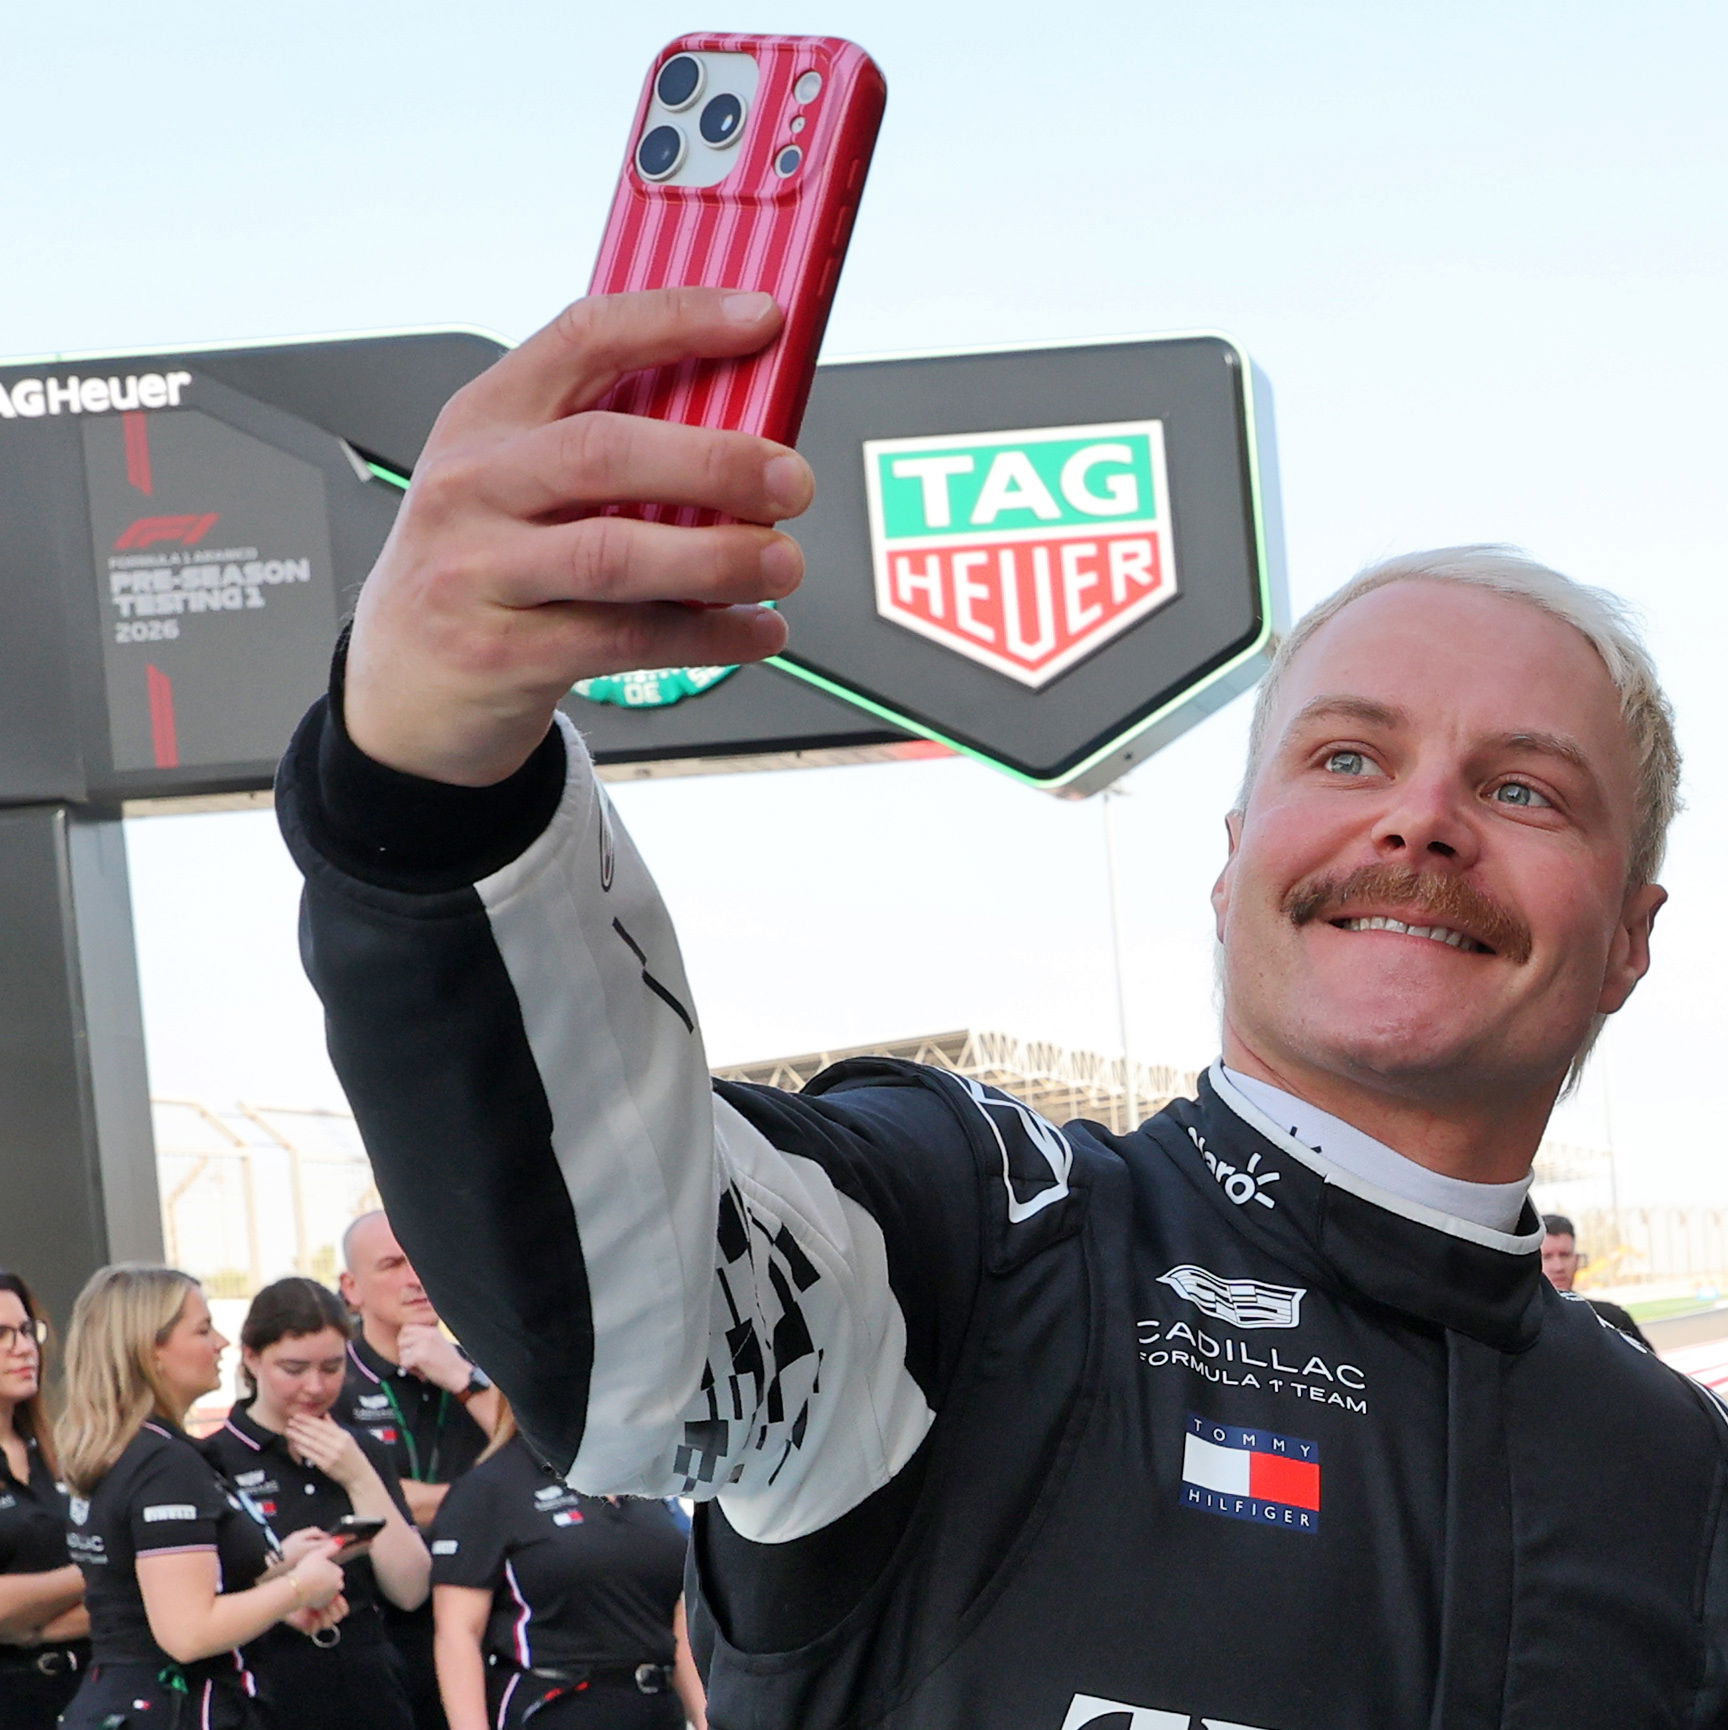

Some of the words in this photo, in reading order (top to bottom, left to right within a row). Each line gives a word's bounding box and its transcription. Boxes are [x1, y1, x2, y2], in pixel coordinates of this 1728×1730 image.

[893, 444, 1139, 528] TAG
[110, 558, 311, 594] PRE-SEASON
[113, 586, 244, 617] TESTING
[896, 539, 1154, 663] HEUER
[115, 617, 181, 643] 2026
[1136, 1320, 1366, 1390] CADILLAC
[1290, 1382, 1367, 1415] TEAM
[1193, 1418, 1311, 1458] TOMMY
[1188, 1488, 1310, 1528] HILFIGER
